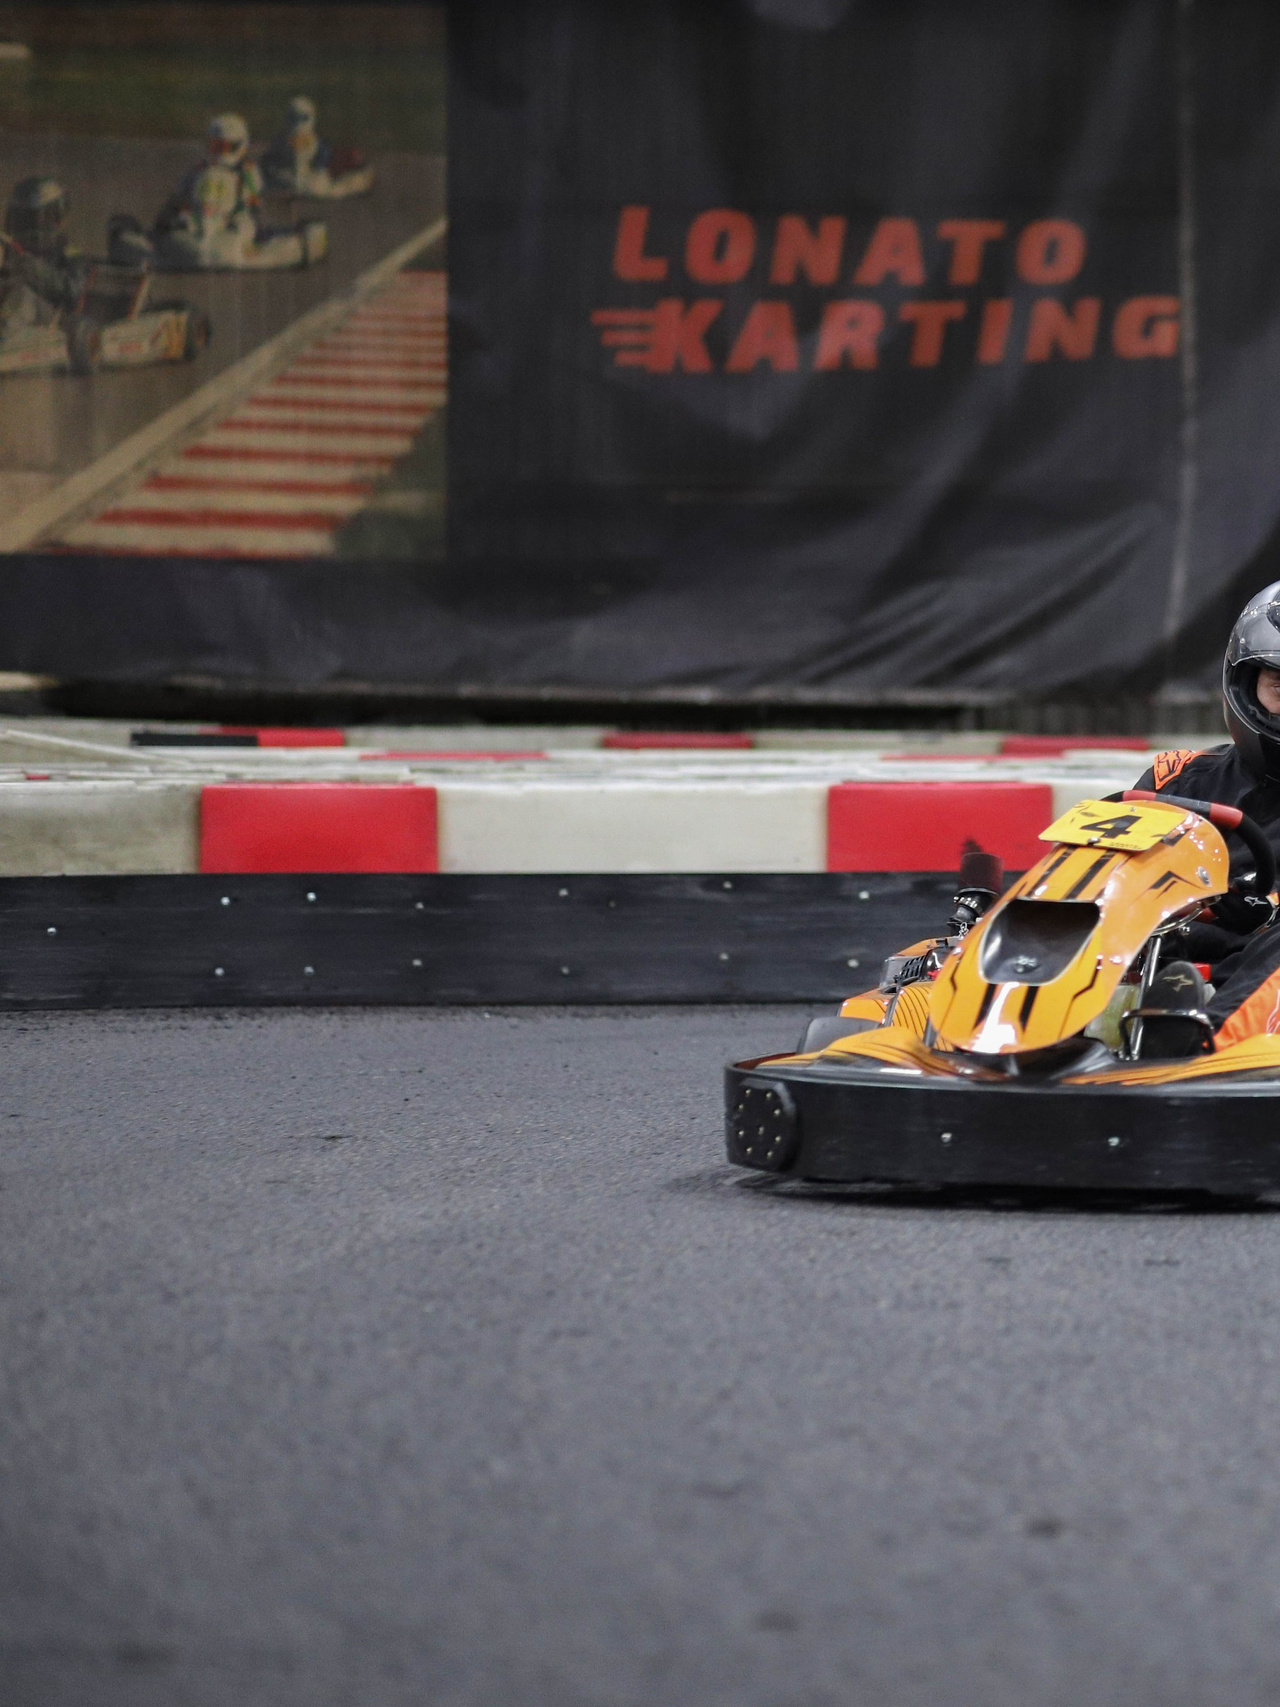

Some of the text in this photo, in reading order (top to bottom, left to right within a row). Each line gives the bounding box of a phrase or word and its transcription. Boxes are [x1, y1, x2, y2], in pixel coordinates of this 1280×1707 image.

[613, 205, 1086, 287] LONATO
[638, 296, 1181, 374] KARTING
[1080, 815, 1143, 839] 4
